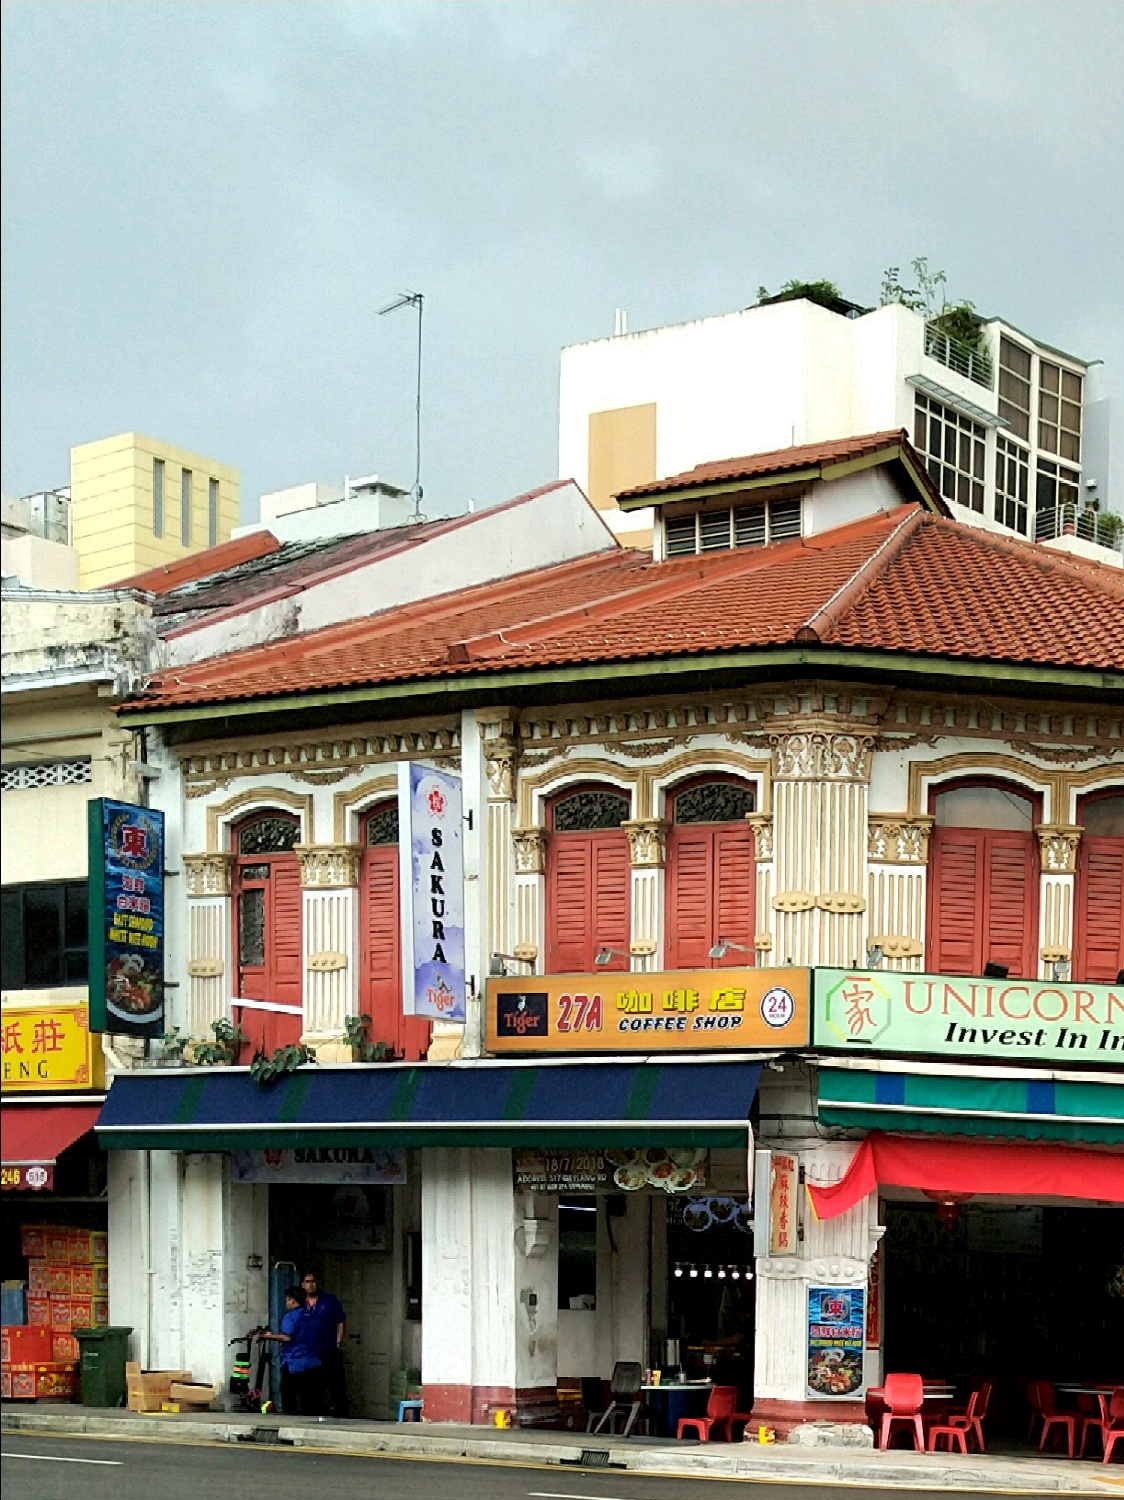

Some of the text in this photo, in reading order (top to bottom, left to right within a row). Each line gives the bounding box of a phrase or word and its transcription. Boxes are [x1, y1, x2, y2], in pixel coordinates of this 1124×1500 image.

[122, 824, 148, 858] 東
[430, 828, 447, 963] SAKURA
[427, 988, 455, 1011] Tiger
[615, 987, 746, 1013] 咖啡店
[768, 996, 787, 1012] 24
[503, 1010, 540, 1034] Tiger
[556, 994, 603, 1032] 27A
[618, 1015, 742, 1031] COFFEE SHOP
[944, 1022, 1047, 1048] Invest
[1055, 1027, 1088, 1049] In
